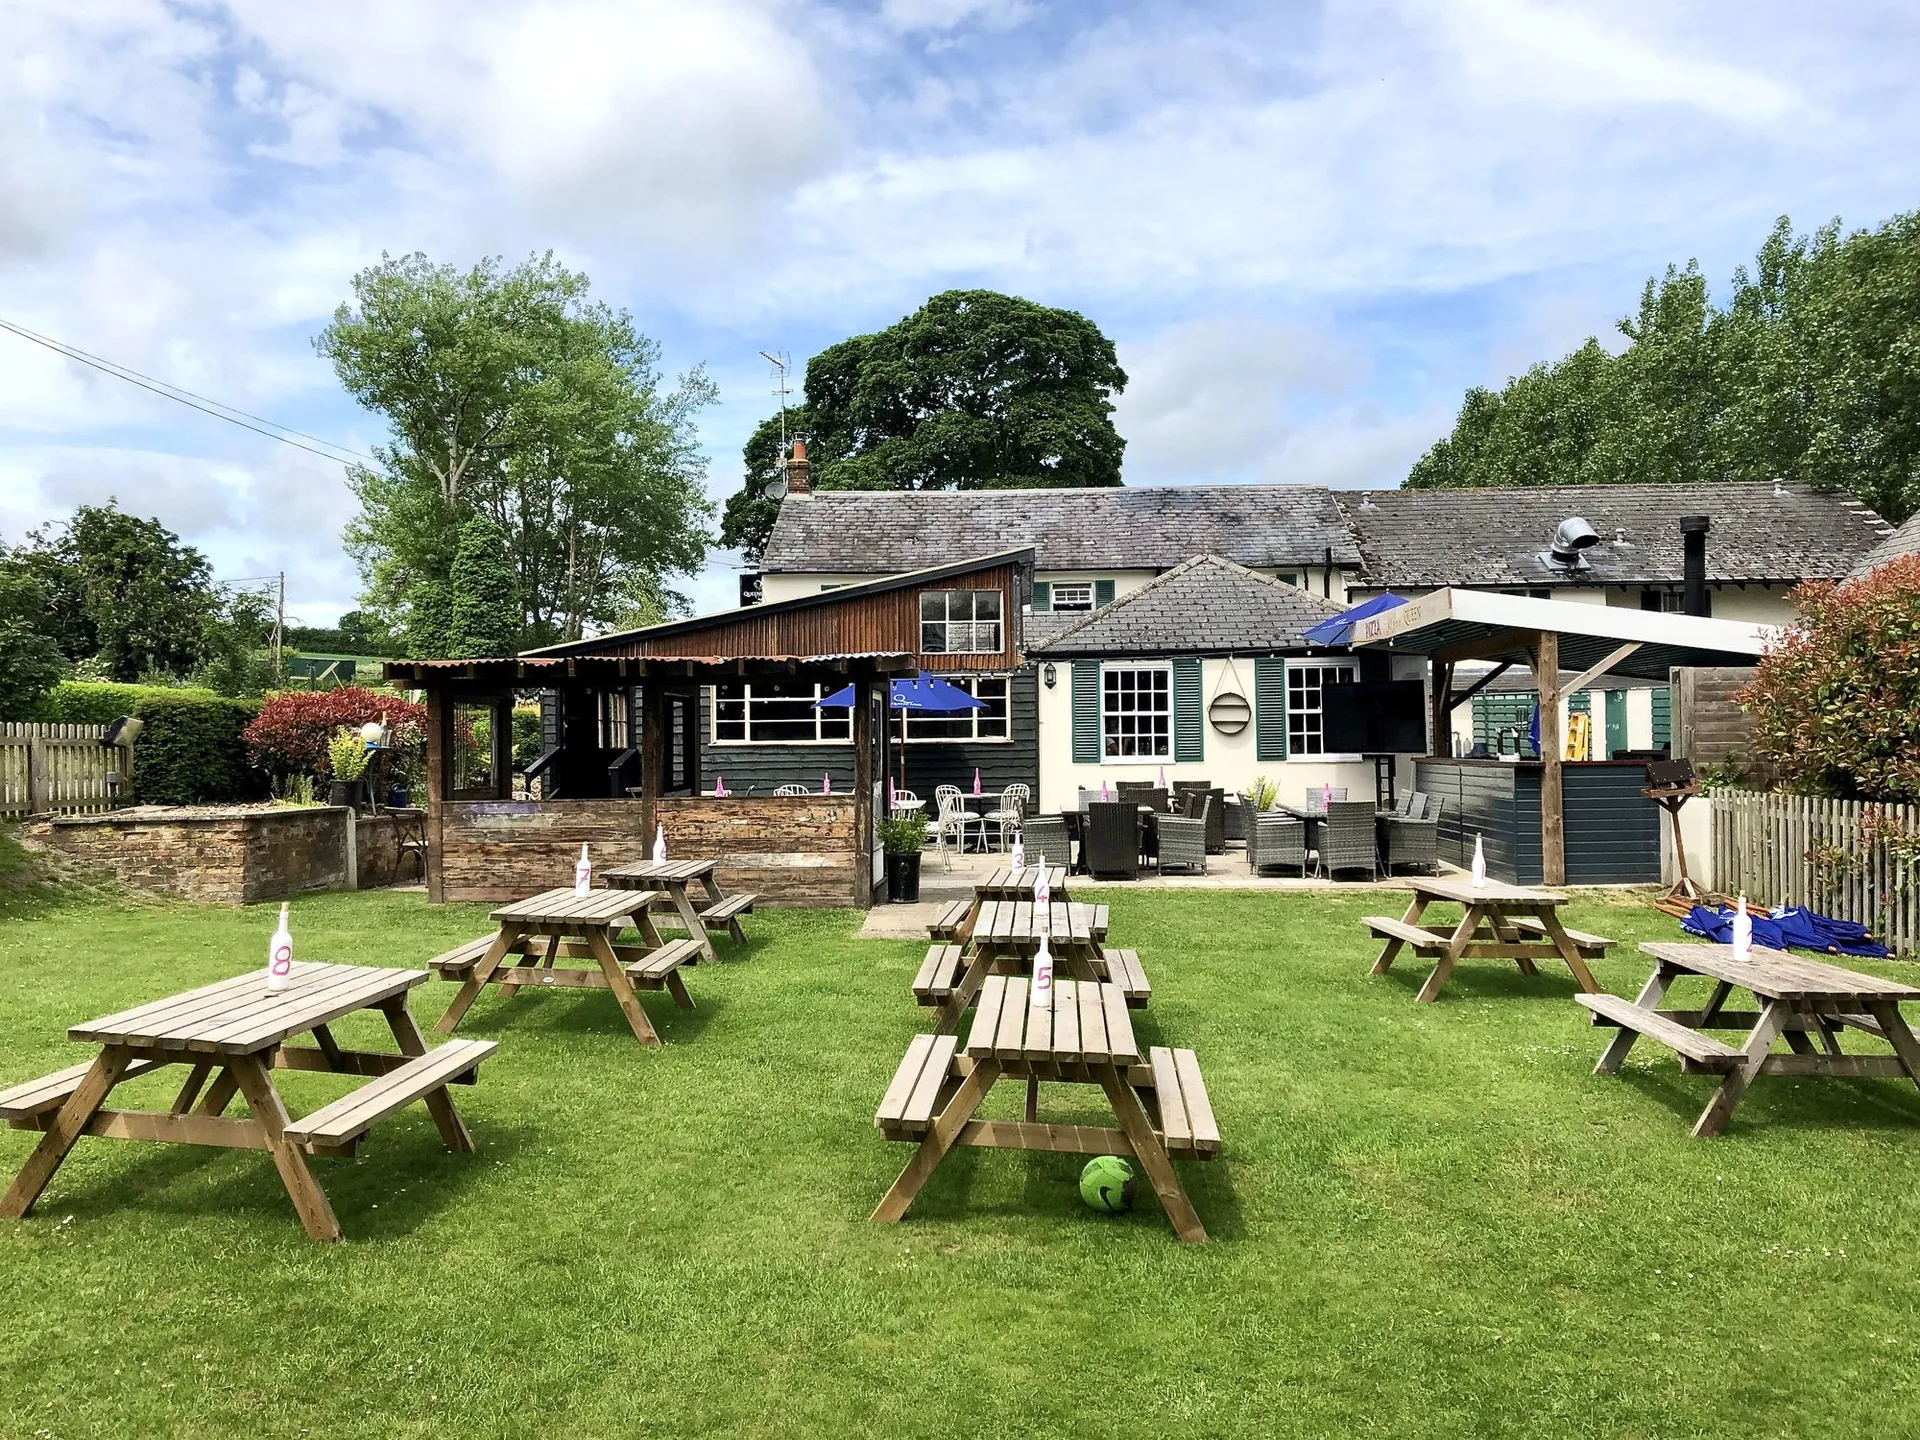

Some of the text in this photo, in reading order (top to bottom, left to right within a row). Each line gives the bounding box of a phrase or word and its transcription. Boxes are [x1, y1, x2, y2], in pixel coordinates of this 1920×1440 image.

[1365, 618, 1382, 639] PIZZA
[1014, 853, 1024, 869] 3
[577, 868, 590, 888] 7
[1036, 885, 1048, 903] 4
[272, 945, 292, 976] 8
[1037, 966, 1052, 990] 5
